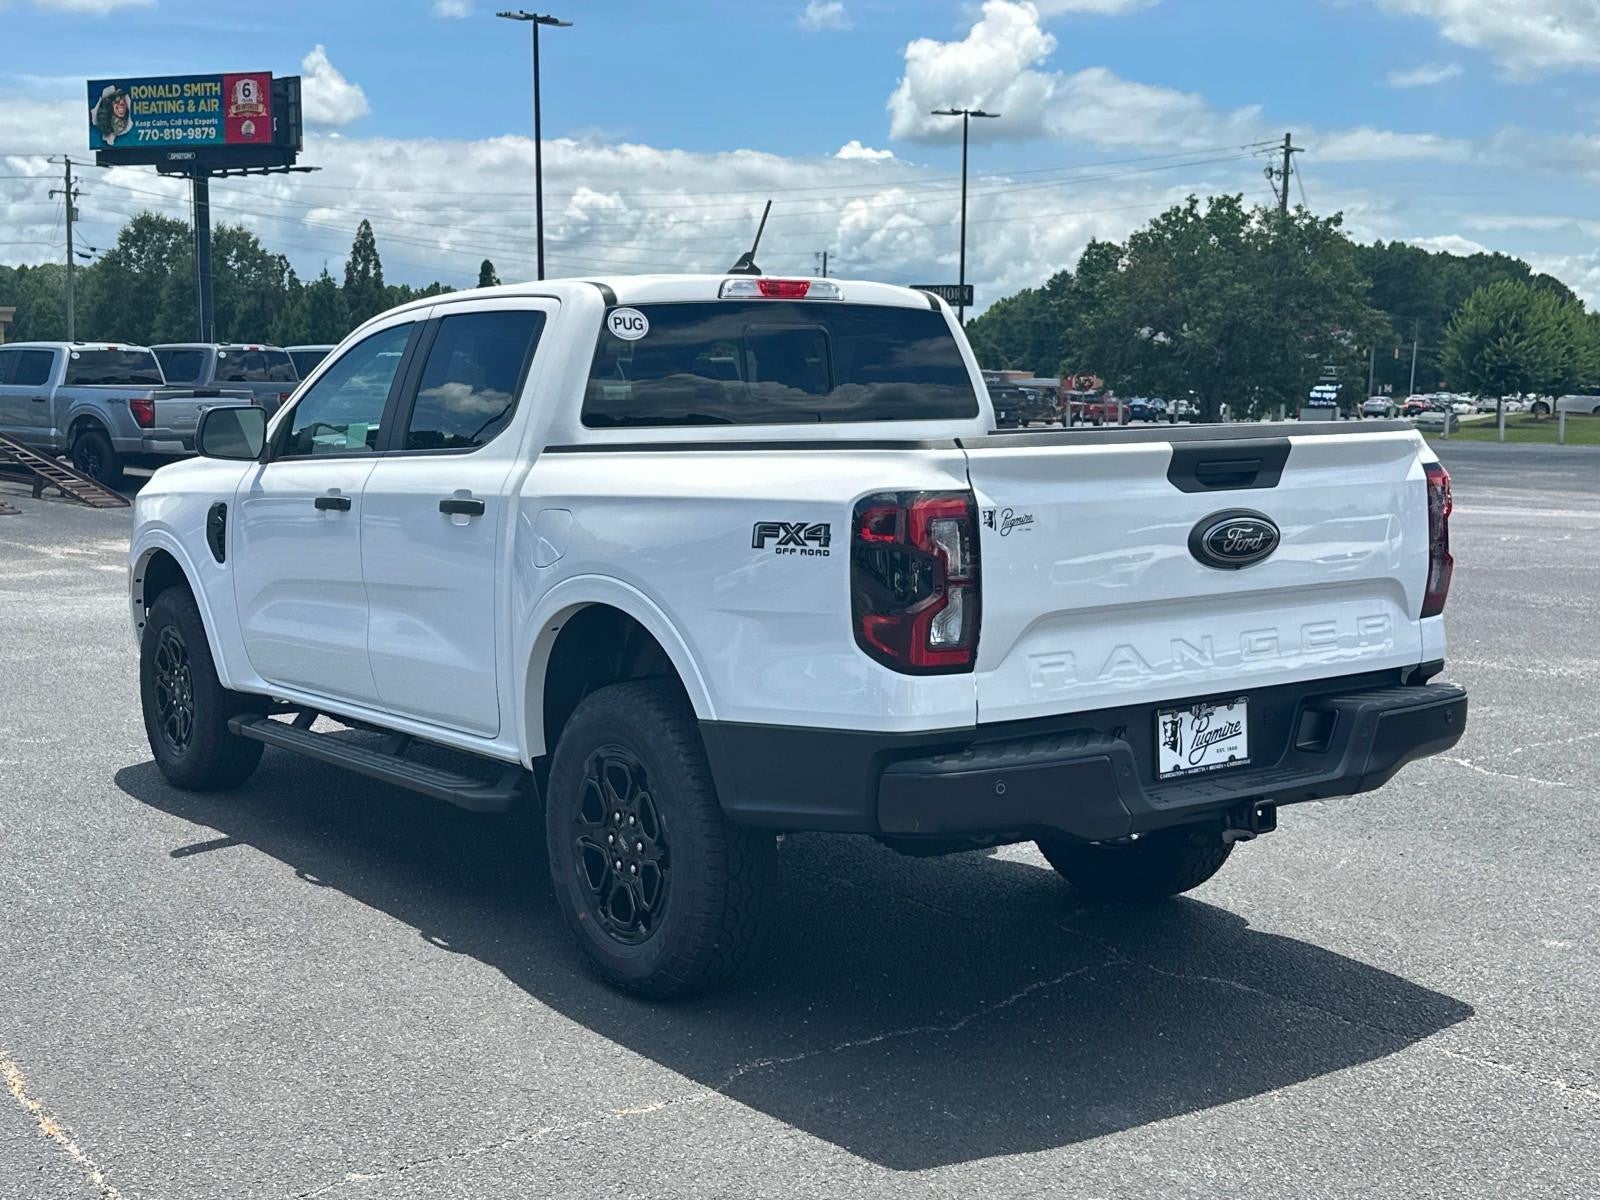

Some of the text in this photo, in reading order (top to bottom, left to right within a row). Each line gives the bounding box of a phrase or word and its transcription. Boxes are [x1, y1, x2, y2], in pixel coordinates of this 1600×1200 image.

[130, 82, 221, 99] RONALD SMITH
[243, 82, 252, 98] 6
[133, 100, 185, 115] HEATING
[187, 99, 196, 113] &
[198, 98, 220, 112] AIR
[135, 120, 151, 128] Keep
[152, 119, 169, 127] Calm,
[182, 118, 193, 126] the
[194, 118, 218, 126] Experts
[137, 126, 216, 141] 770-819-9879
[613, 316, 644, 331] PUG
[751, 521, 831, 549] FX4
[1223, 527, 1264, 553] Ford
[775, 547, 830, 557] OFF ROAD
[1028, 615, 1392, 687] RANGER
[1189, 715, 1243, 766] Pugmire
